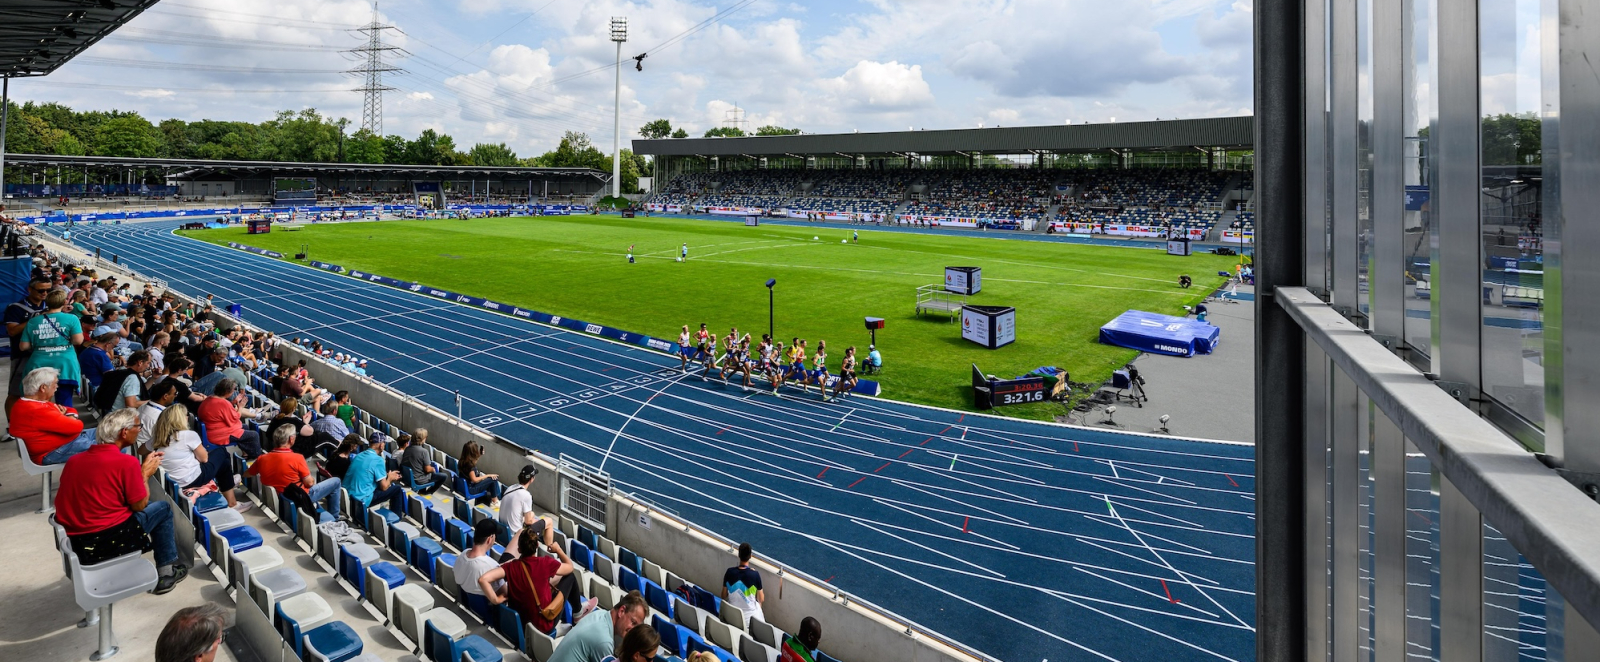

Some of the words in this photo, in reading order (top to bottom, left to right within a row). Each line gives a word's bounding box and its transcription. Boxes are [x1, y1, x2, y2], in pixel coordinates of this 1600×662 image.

[587, 325, 601, 333] REWE
[1160, 345, 1188, 354] MONDO
[579, 391, 599, 399] 5
[1003, 391, 1043, 404] 3:21.6
[550, 398, 570, 406] 6
[516, 407, 537, 415] 7
[479, 417, 502, 425] 8
